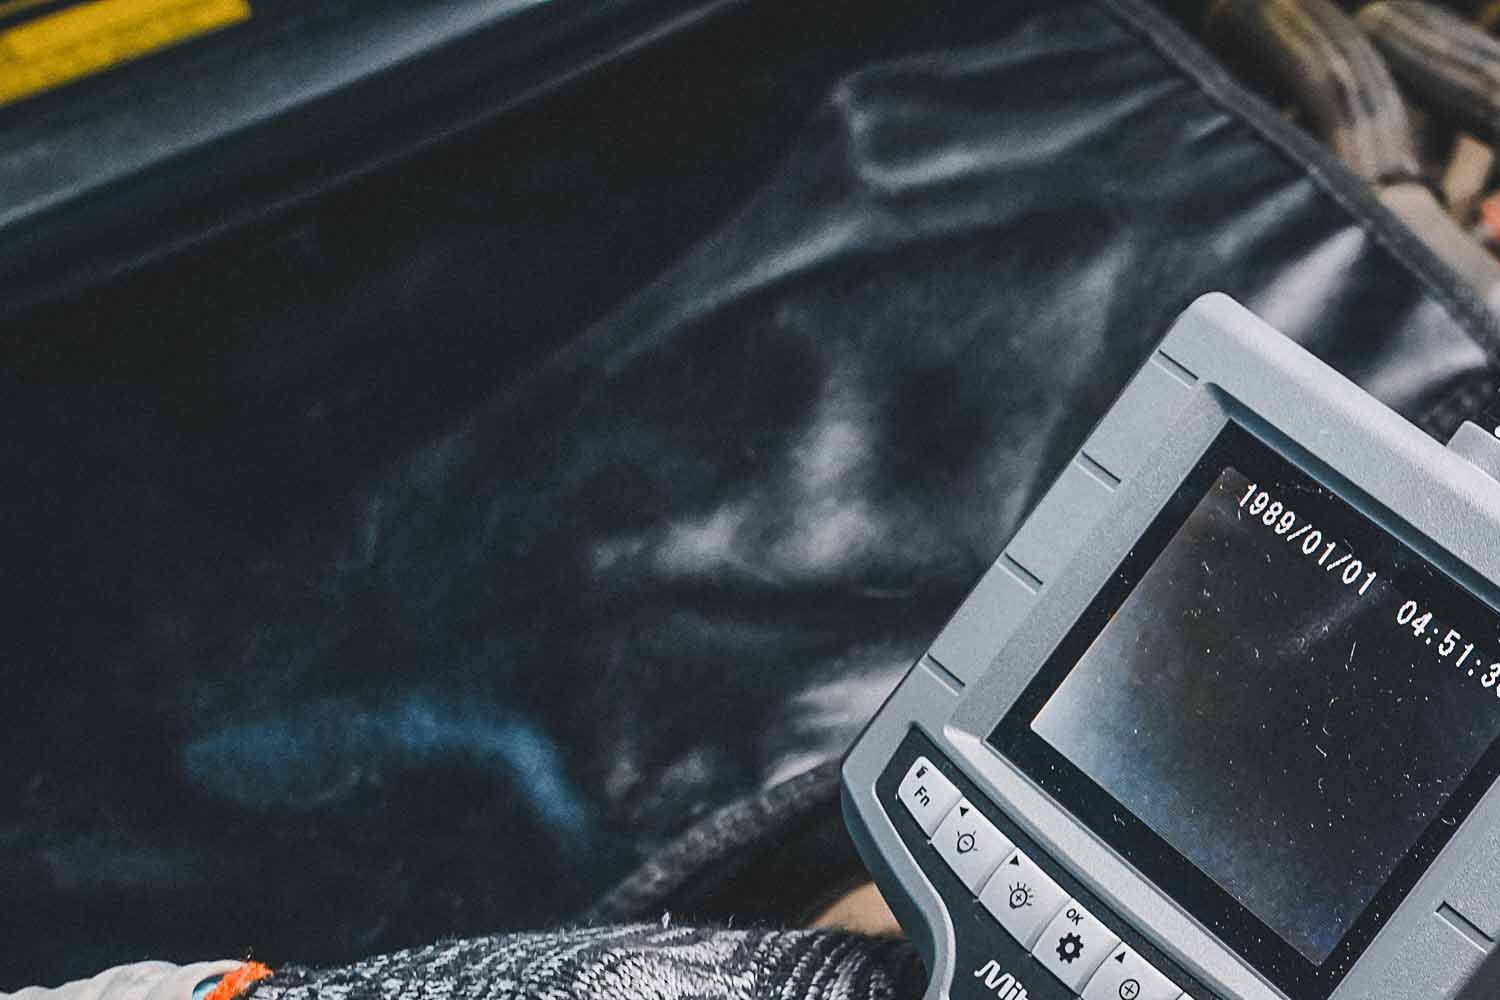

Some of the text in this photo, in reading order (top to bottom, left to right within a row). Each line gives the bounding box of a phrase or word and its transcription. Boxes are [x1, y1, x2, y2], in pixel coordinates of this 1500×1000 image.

[1238, 483, 1377, 596] 1989/01/01
[913, 785, 931, 808] Fn
[1065, 907, 1085, 926] OK
